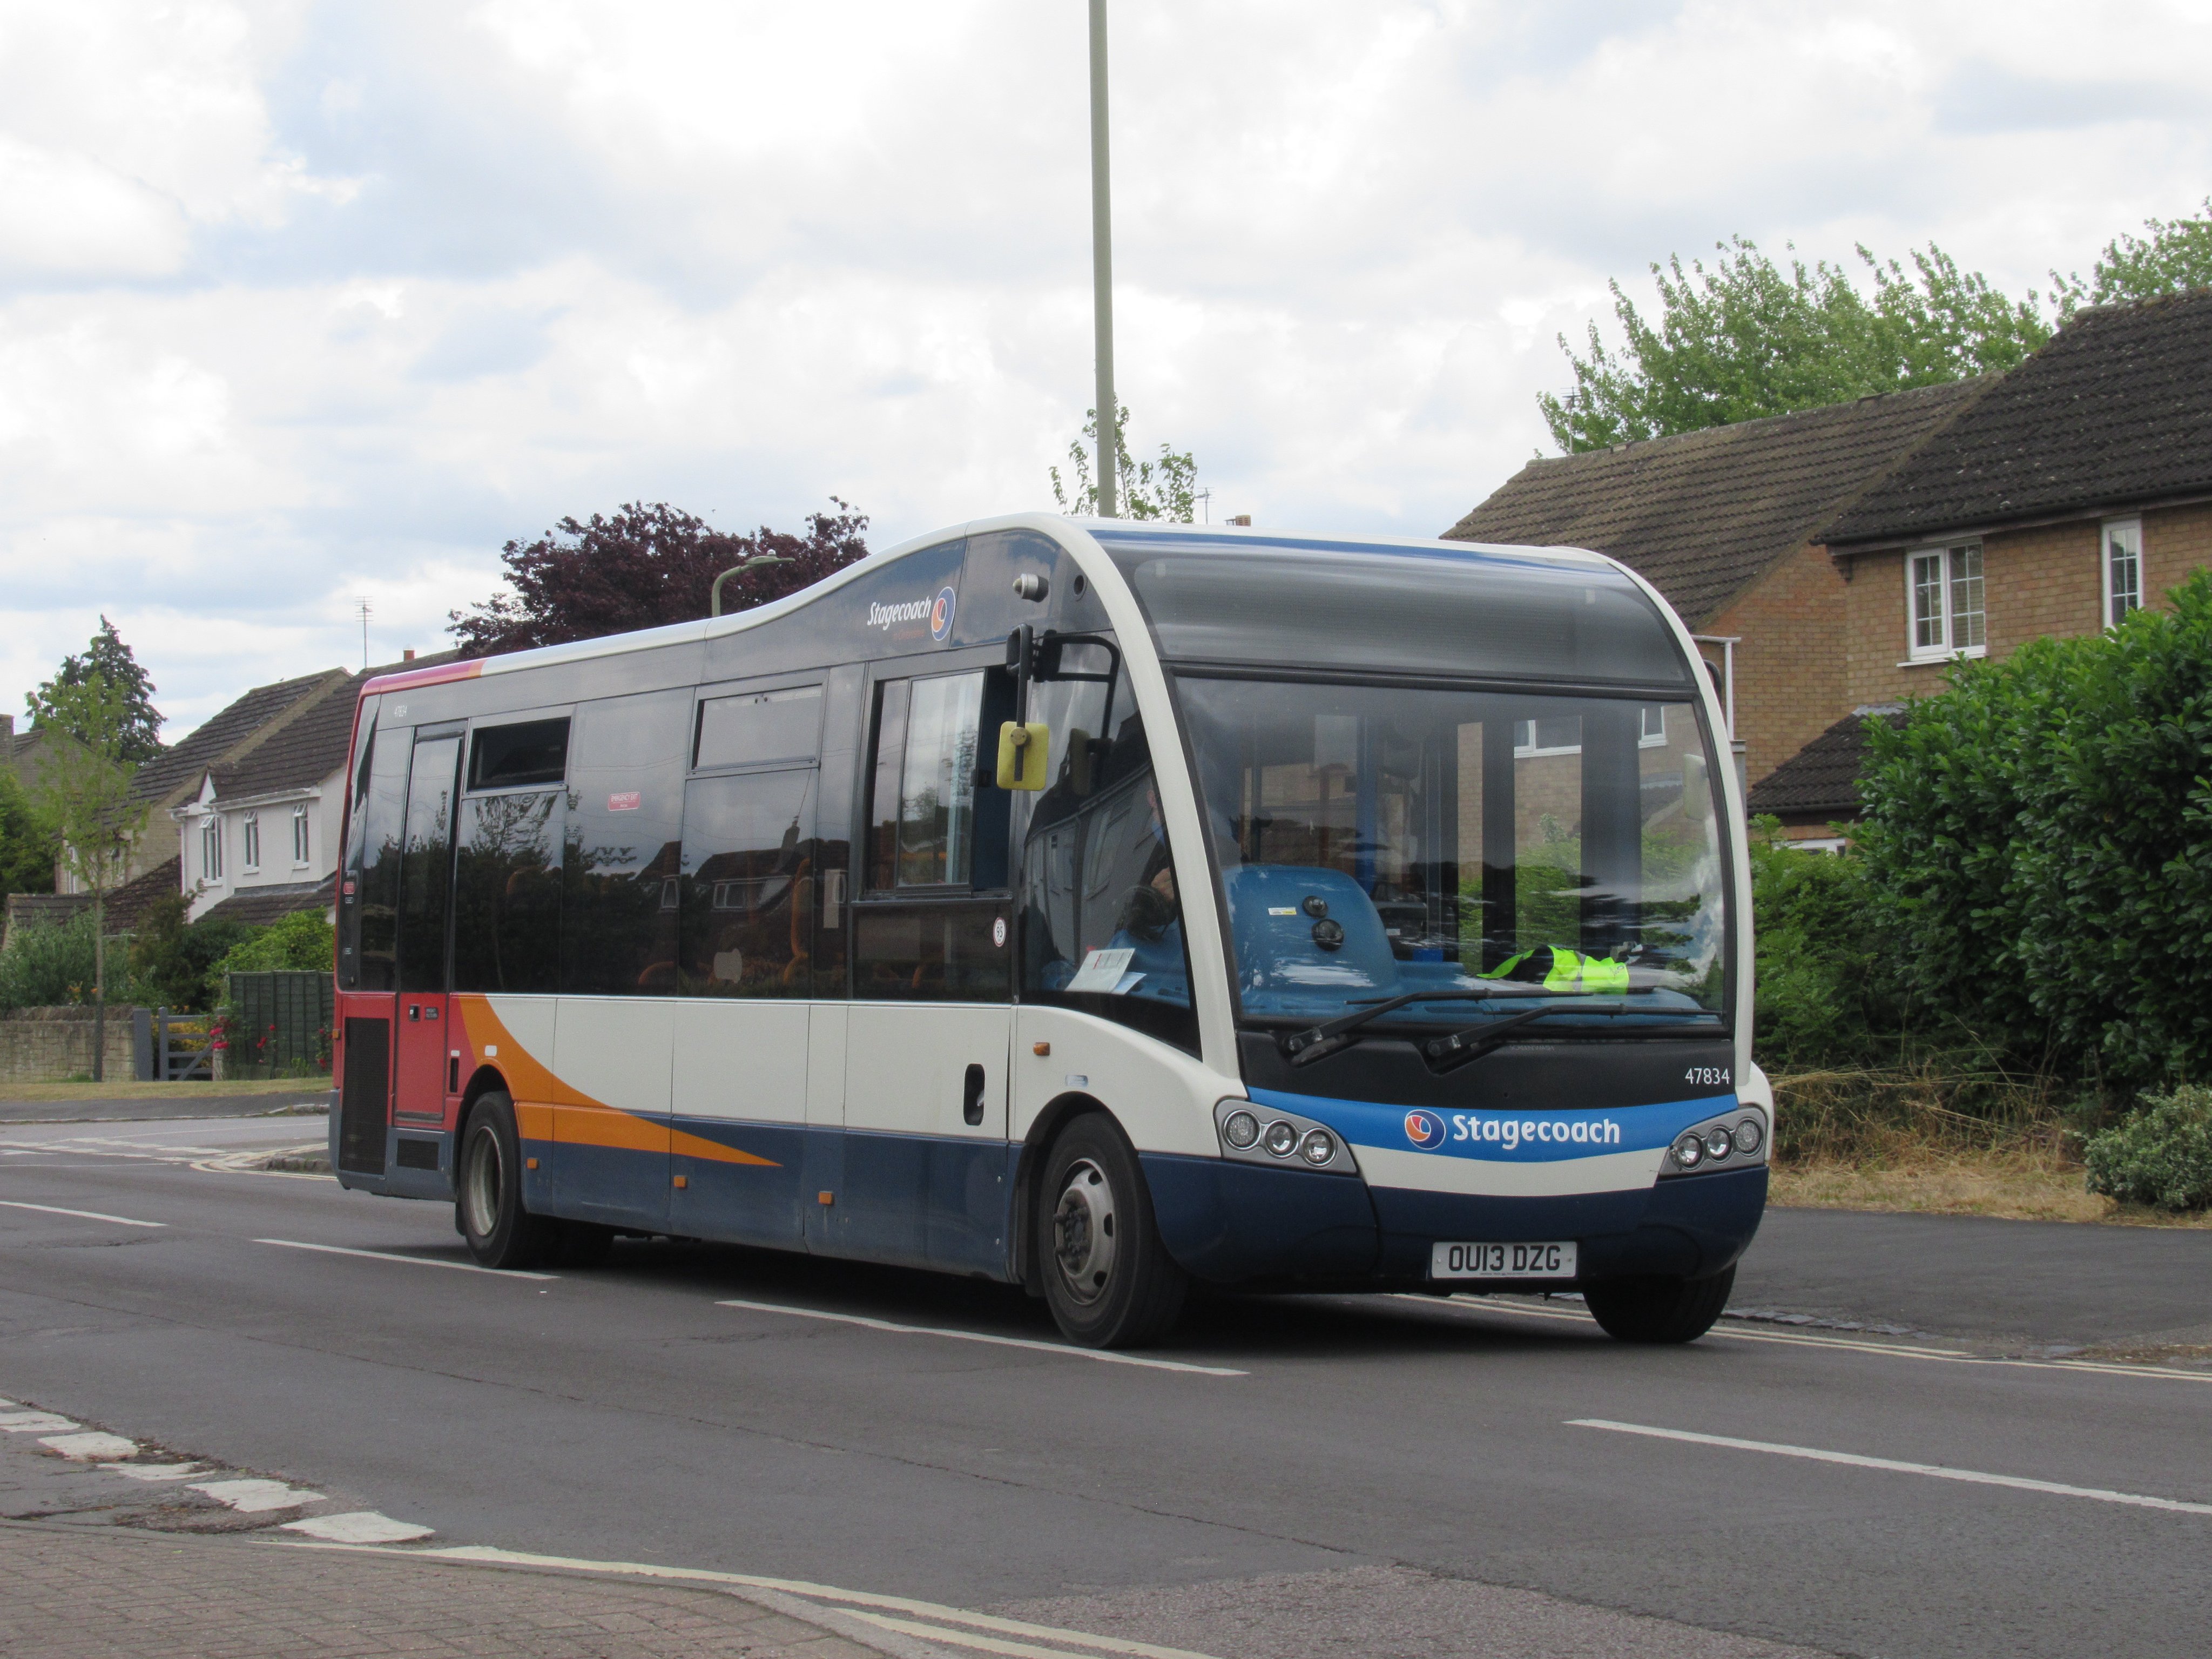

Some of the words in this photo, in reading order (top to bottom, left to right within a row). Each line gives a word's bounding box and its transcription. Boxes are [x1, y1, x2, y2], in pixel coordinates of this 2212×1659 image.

[867, 596, 932, 630] Stagecoach
[996, 926, 1003, 938] 95
[1685, 1068, 1730, 1084] 47834
[1453, 1115, 1620, 1150] Stagecoach
[1449, 1245, 1505, 1271] OU13
[1513, 1245, 1561, 1271] DZG
